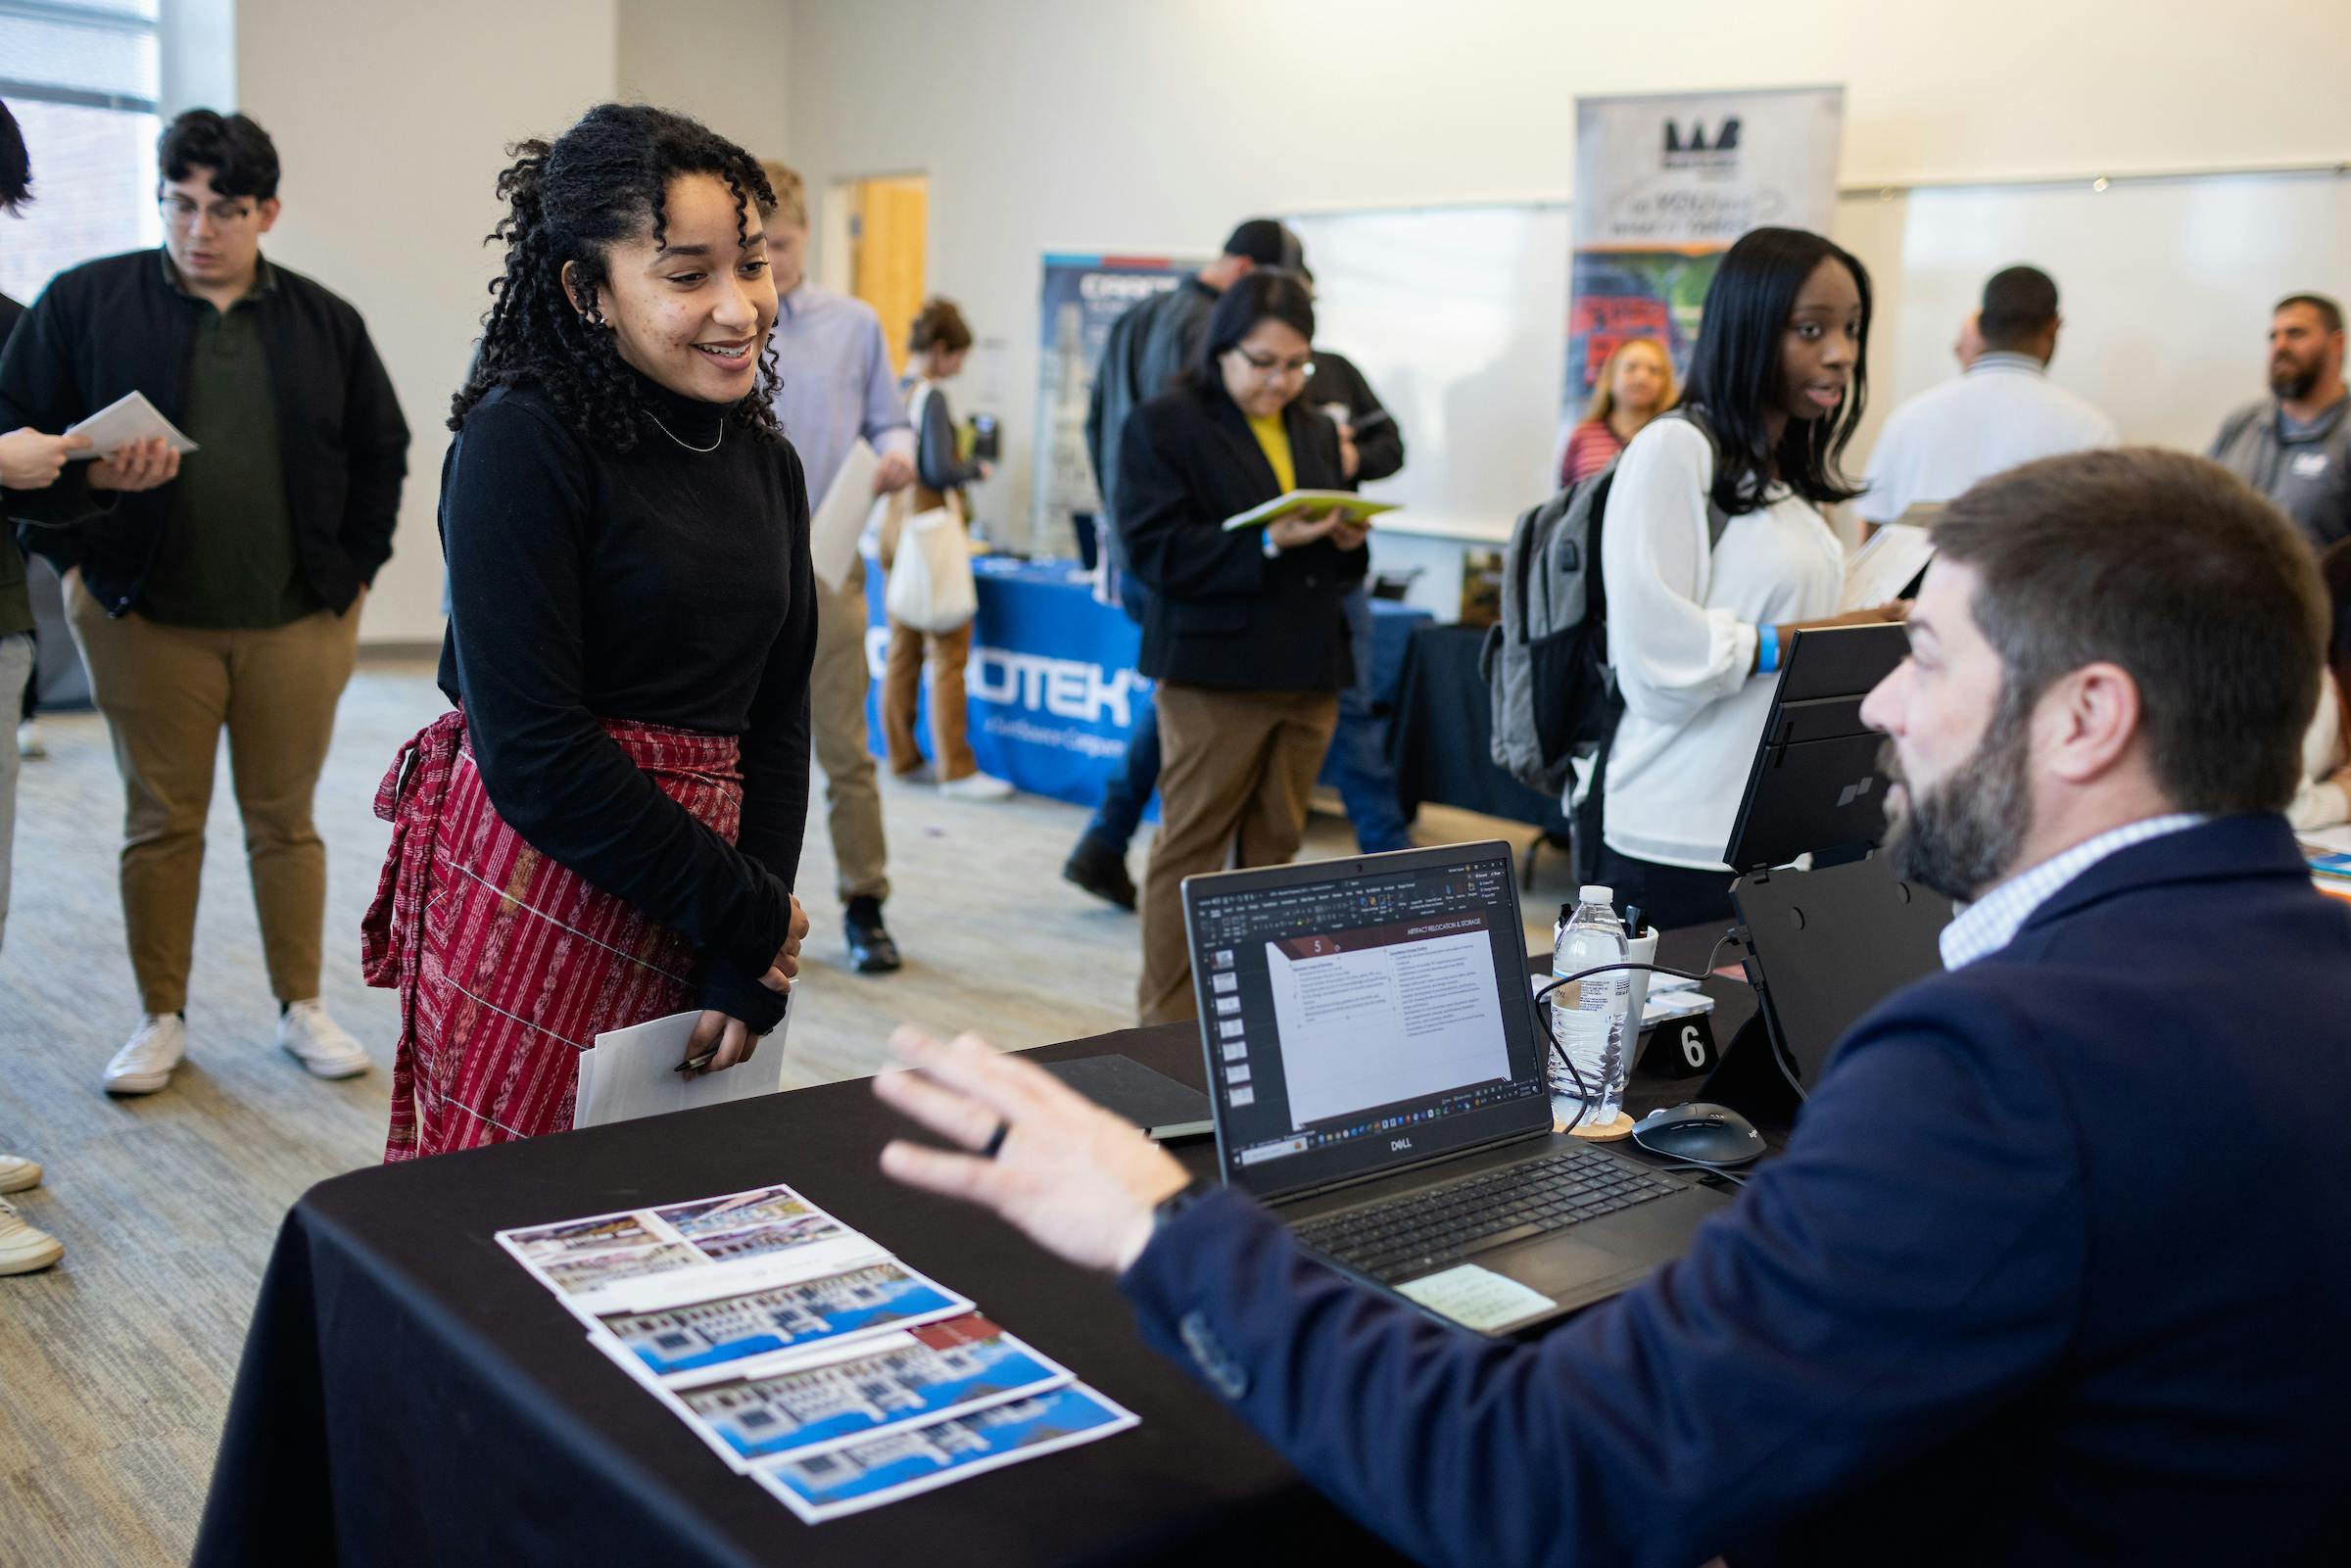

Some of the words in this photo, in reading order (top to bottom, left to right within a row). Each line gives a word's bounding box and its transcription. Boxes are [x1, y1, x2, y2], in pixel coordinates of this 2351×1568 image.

[1408, 925, 1428, 934] ARTIFACT
[1428, 922, 1457, 932] RELOCATION
[1462, 917, 1482, 927] STORAGE
[1314, 939, 1322, 953] 5
[1681, 1024, 1706, 1068] 6
[1390, 1136, 1413, 1151] DELL
